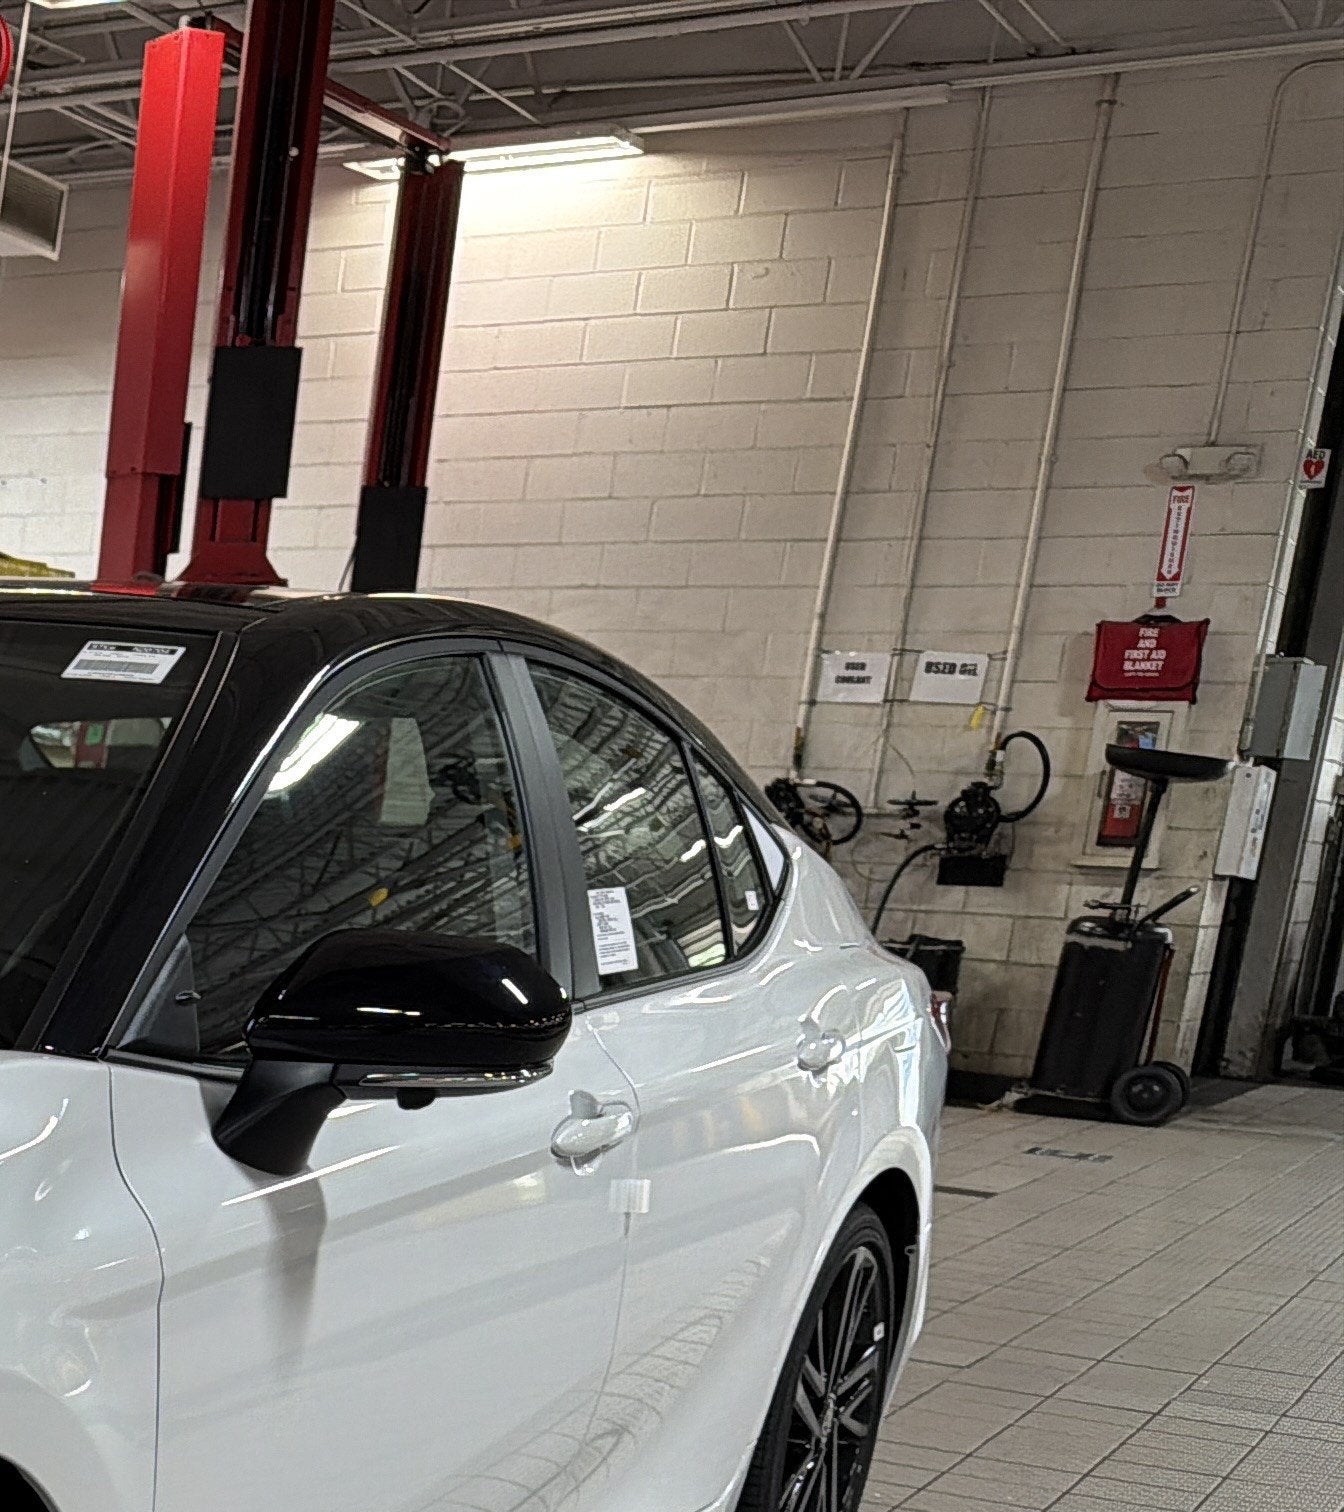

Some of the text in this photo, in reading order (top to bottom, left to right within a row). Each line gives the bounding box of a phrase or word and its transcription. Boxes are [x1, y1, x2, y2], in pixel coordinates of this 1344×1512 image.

[1305, 449, 1326, 459] AED
[1172, 494, 1190, 504] FIRE
[1138, 627, 1160, 638] FIRE
[1137, 638, 1158, 649] AND
[1124, 649, 1167, 660] FIRST AID
[925, 661, 956, 674] USED
[1122, 660, 1165, 671] BLANKET
